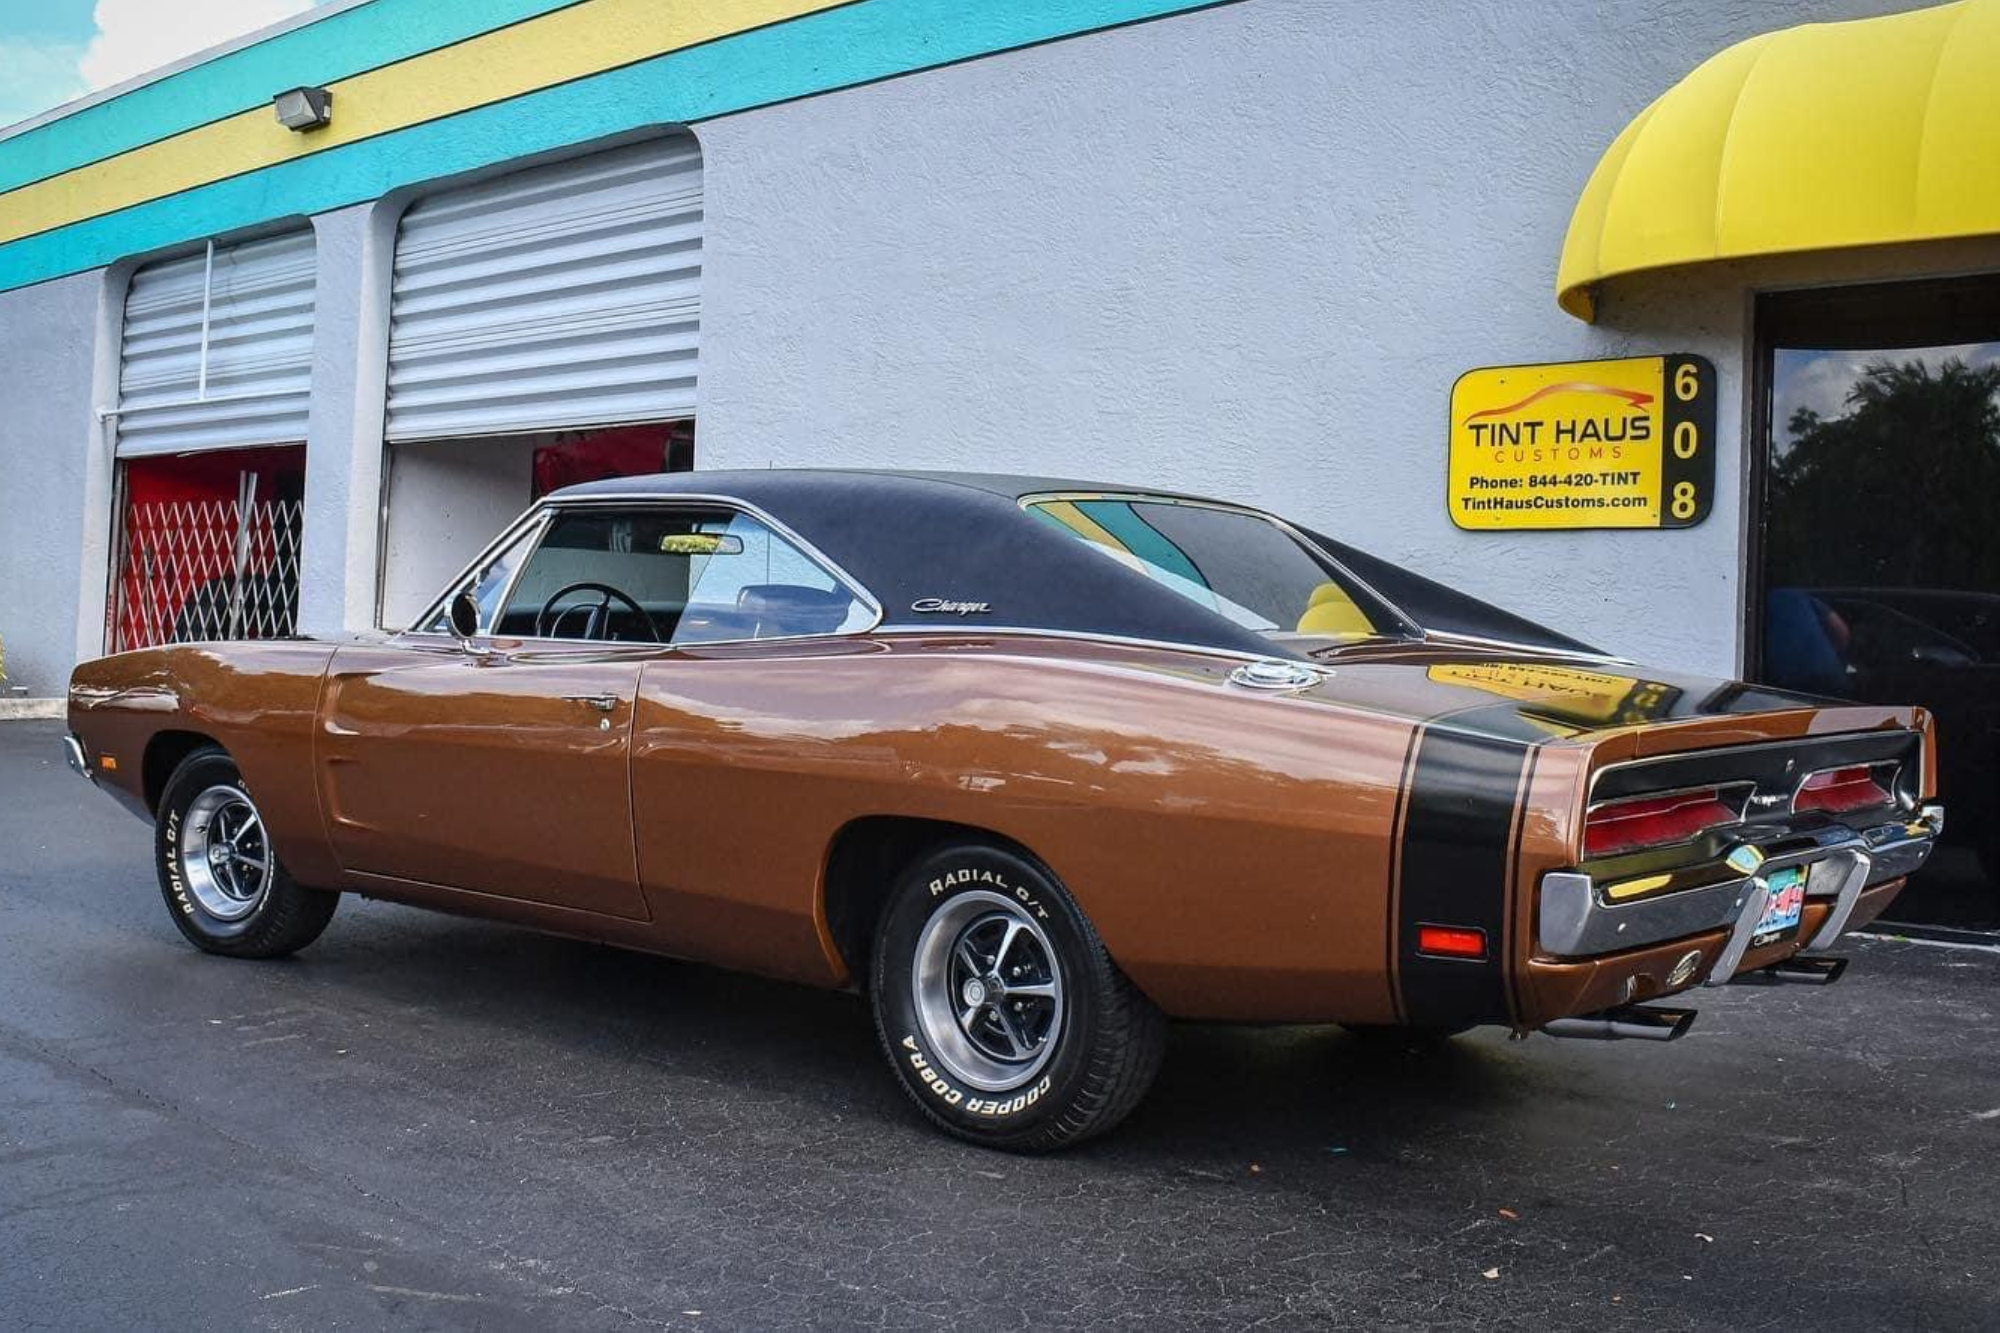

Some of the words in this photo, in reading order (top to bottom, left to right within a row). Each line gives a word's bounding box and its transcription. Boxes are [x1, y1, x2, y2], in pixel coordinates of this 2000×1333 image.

[1468, 421, 1544, 447] TINT
[1555, 415, 1651, 444] HAUS
[1494, 446, 1623, 463] CUSTOMS
[1469, 475, 1524, 489] Phone:
[1528, 471, 1641, 488] 844-420-TINT
[1462, 495, 1648, 511] TintHausCustoms.com
[911, 598, 993, 616] Charger
[166, 847, 195, 914] RADIAL
[929, 868, 1008, 896] RADIAL
[1015, 886, 1049, 918] G/T
[902, 1035, 963, 1105] COBRA
[965, 1074, 1052, 1115] COOPER
